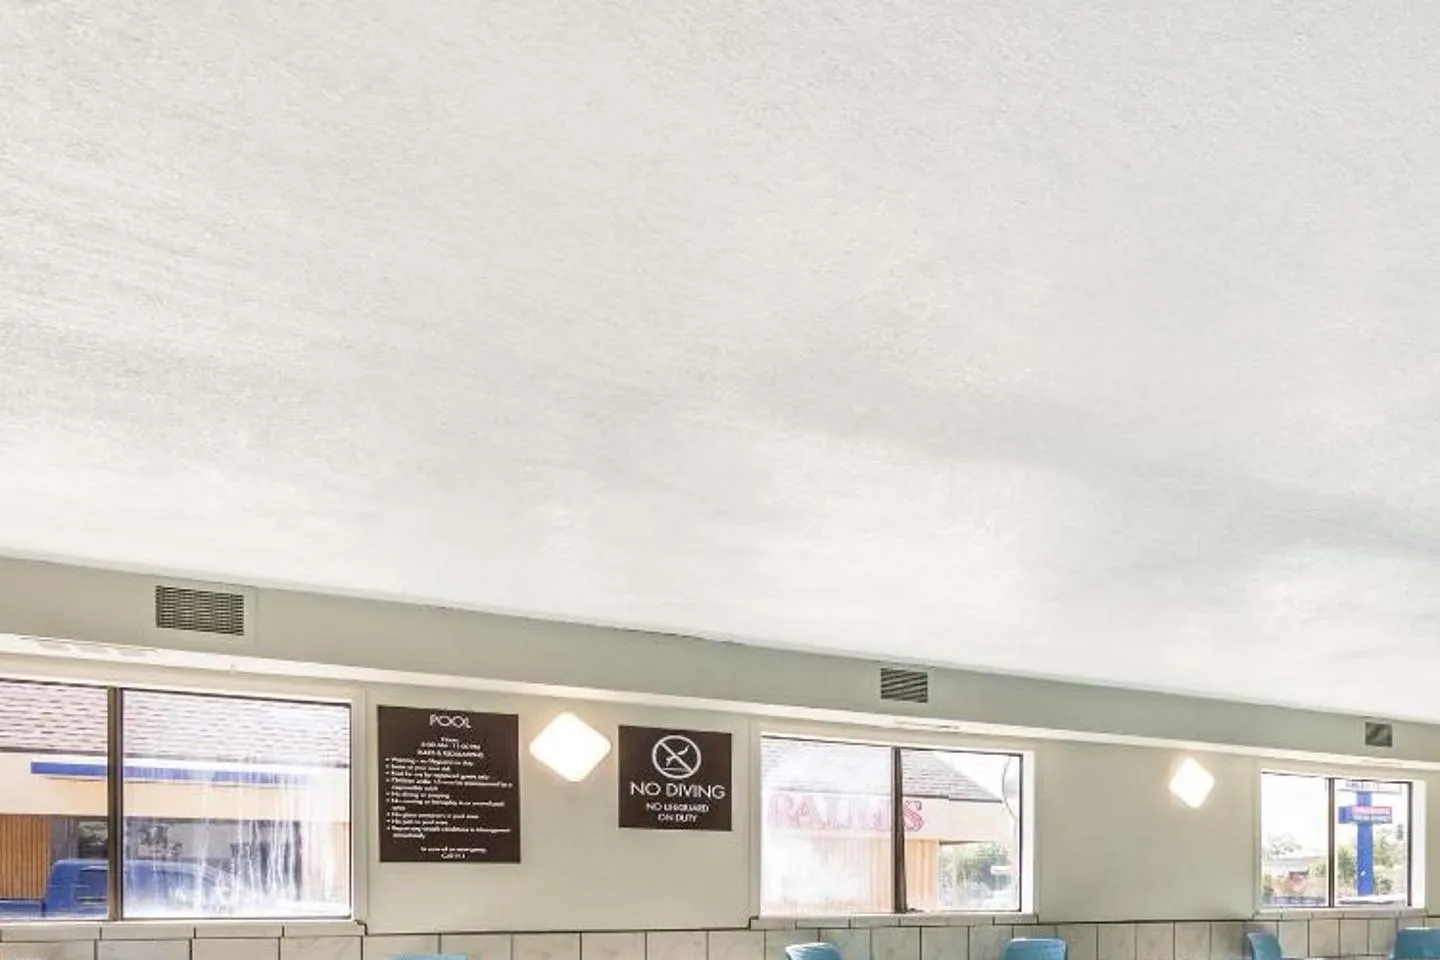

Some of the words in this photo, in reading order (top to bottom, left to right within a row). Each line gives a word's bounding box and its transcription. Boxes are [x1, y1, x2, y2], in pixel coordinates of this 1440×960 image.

[429, 713, 472, 729] POOL
[629, 781, 661, 796] NO
[665, 782, 726, 799] DIVING
[645, 802, 663, 811] NO
[664, 803, 710, 813] LIFEGUARD
[657, 813, 674, 822] ON
[675, 814, 698, 823] DUTY
